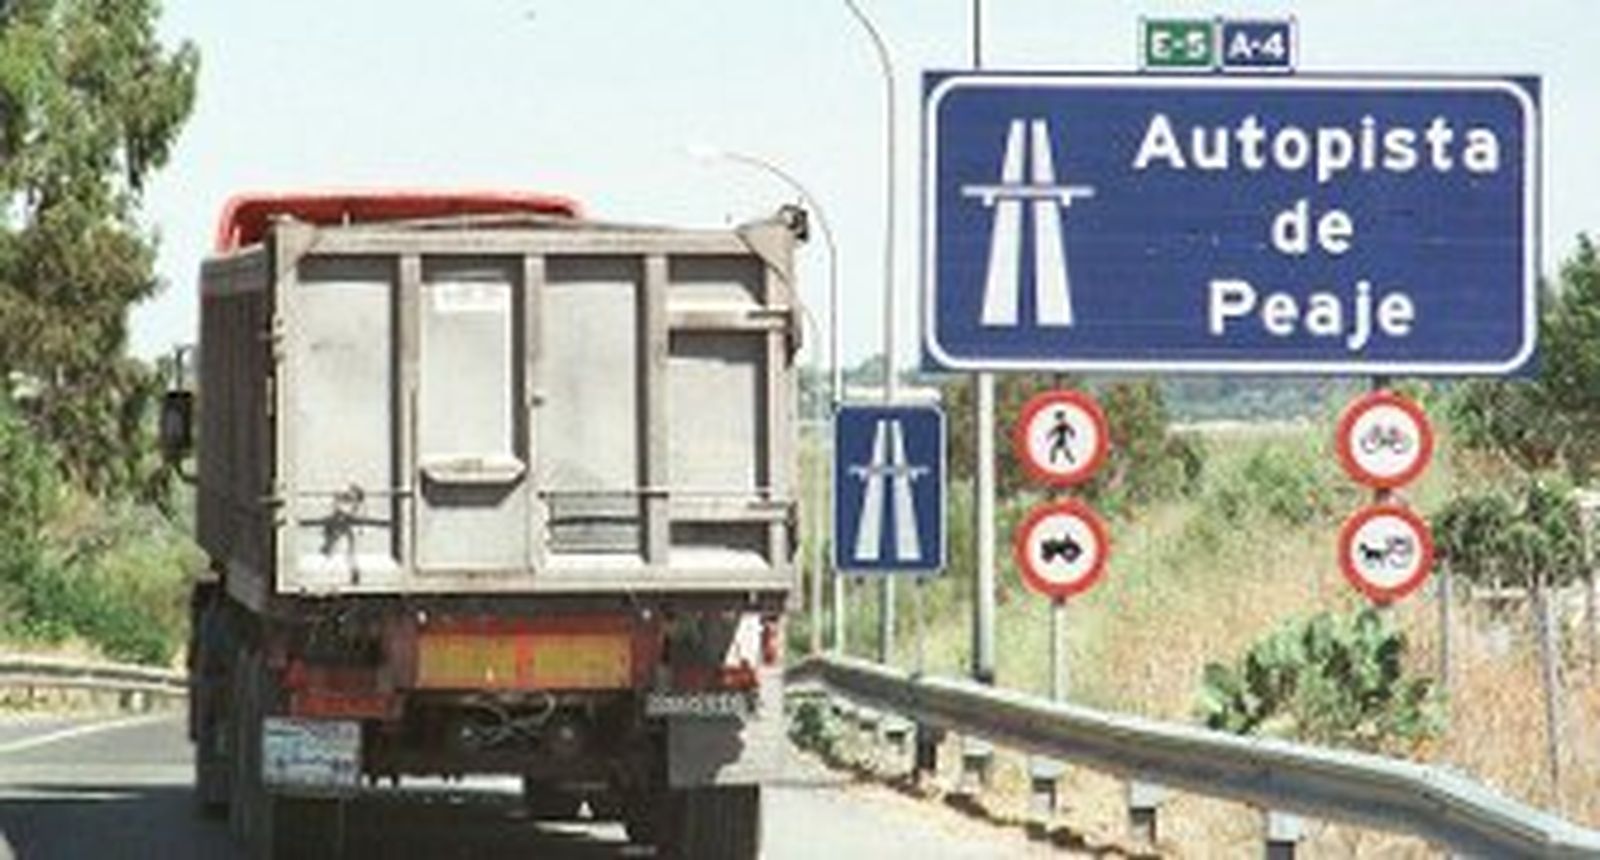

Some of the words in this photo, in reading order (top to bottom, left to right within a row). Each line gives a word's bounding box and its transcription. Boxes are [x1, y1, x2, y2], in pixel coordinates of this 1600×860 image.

[1151, 31, 1207, 59] E-5
[1228, 31, 1286, 59] A-4
[1133, 114, 1500, 183] Autopista
[1272, 199, 1354, 254] de
[1209, 280, 1415, 351] Peaje
